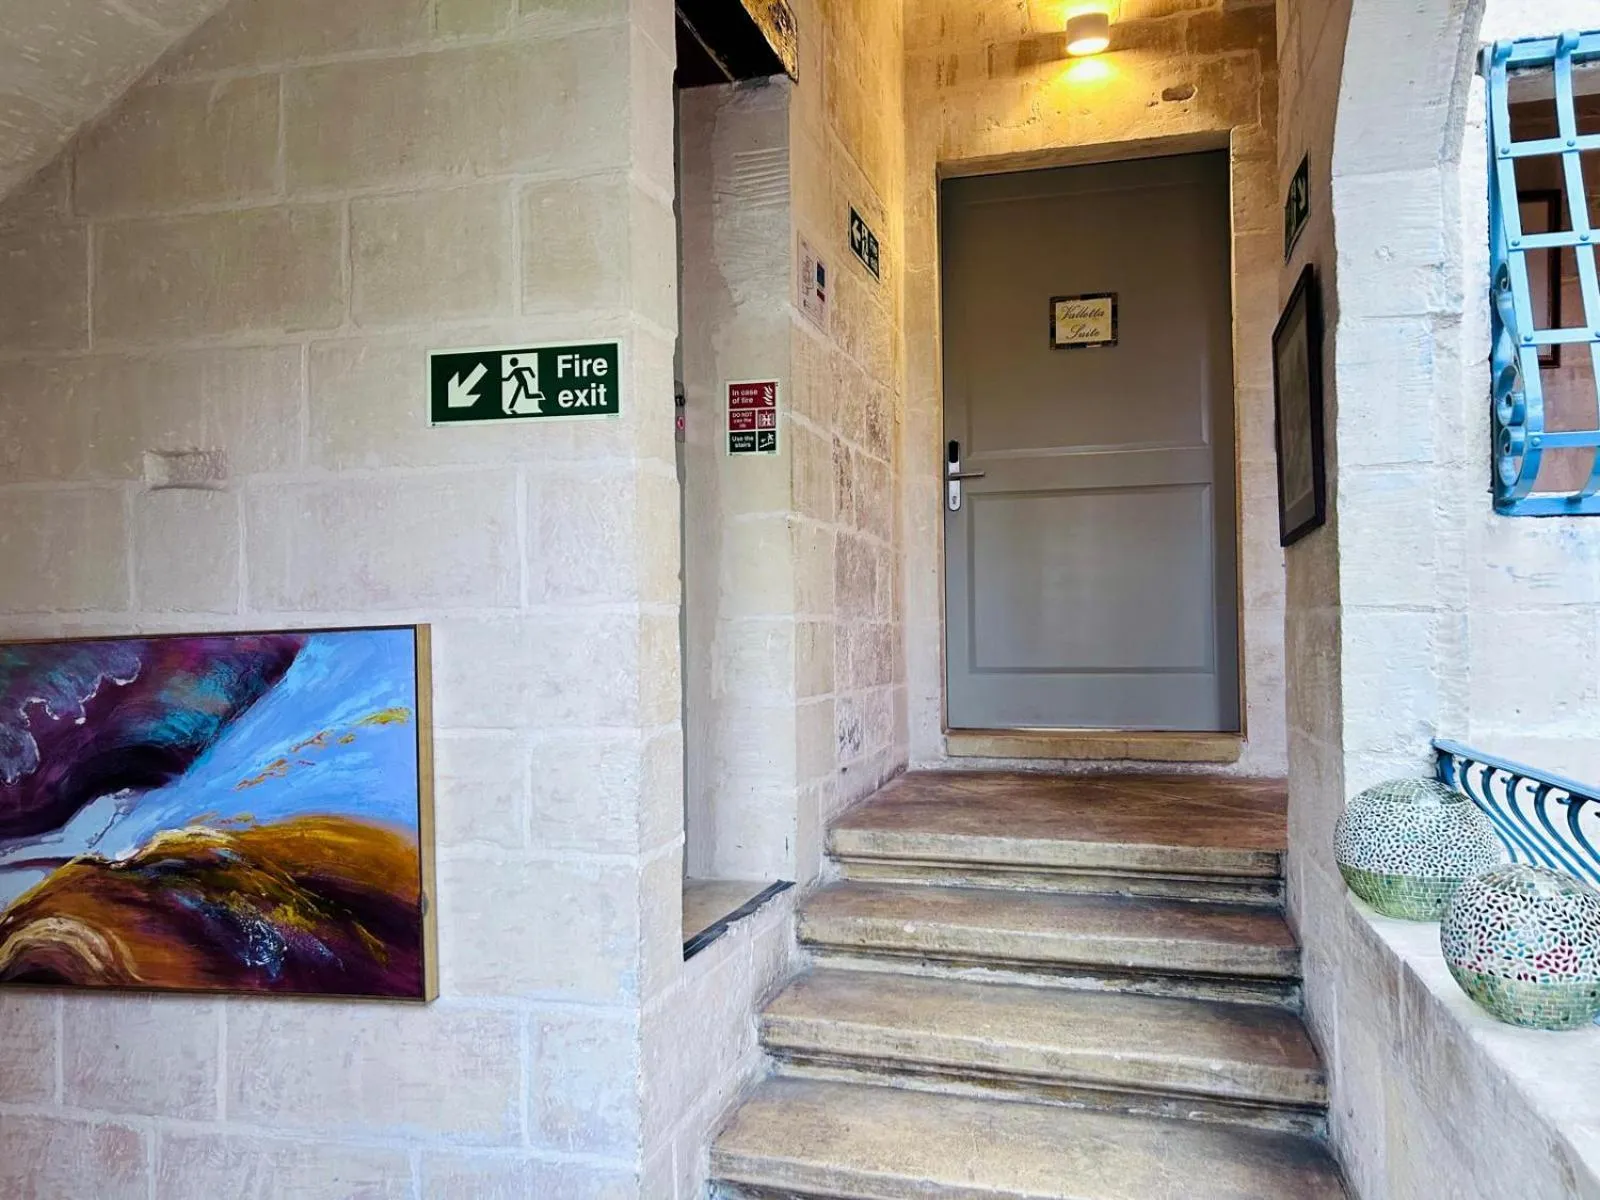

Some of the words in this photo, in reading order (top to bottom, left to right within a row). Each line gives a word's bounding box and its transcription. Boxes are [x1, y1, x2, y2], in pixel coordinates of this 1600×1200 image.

[1066, 324, 1101, 340] Suite
[557, 354, 608, 378] Fire
[557, 383, 608, 408] exit
